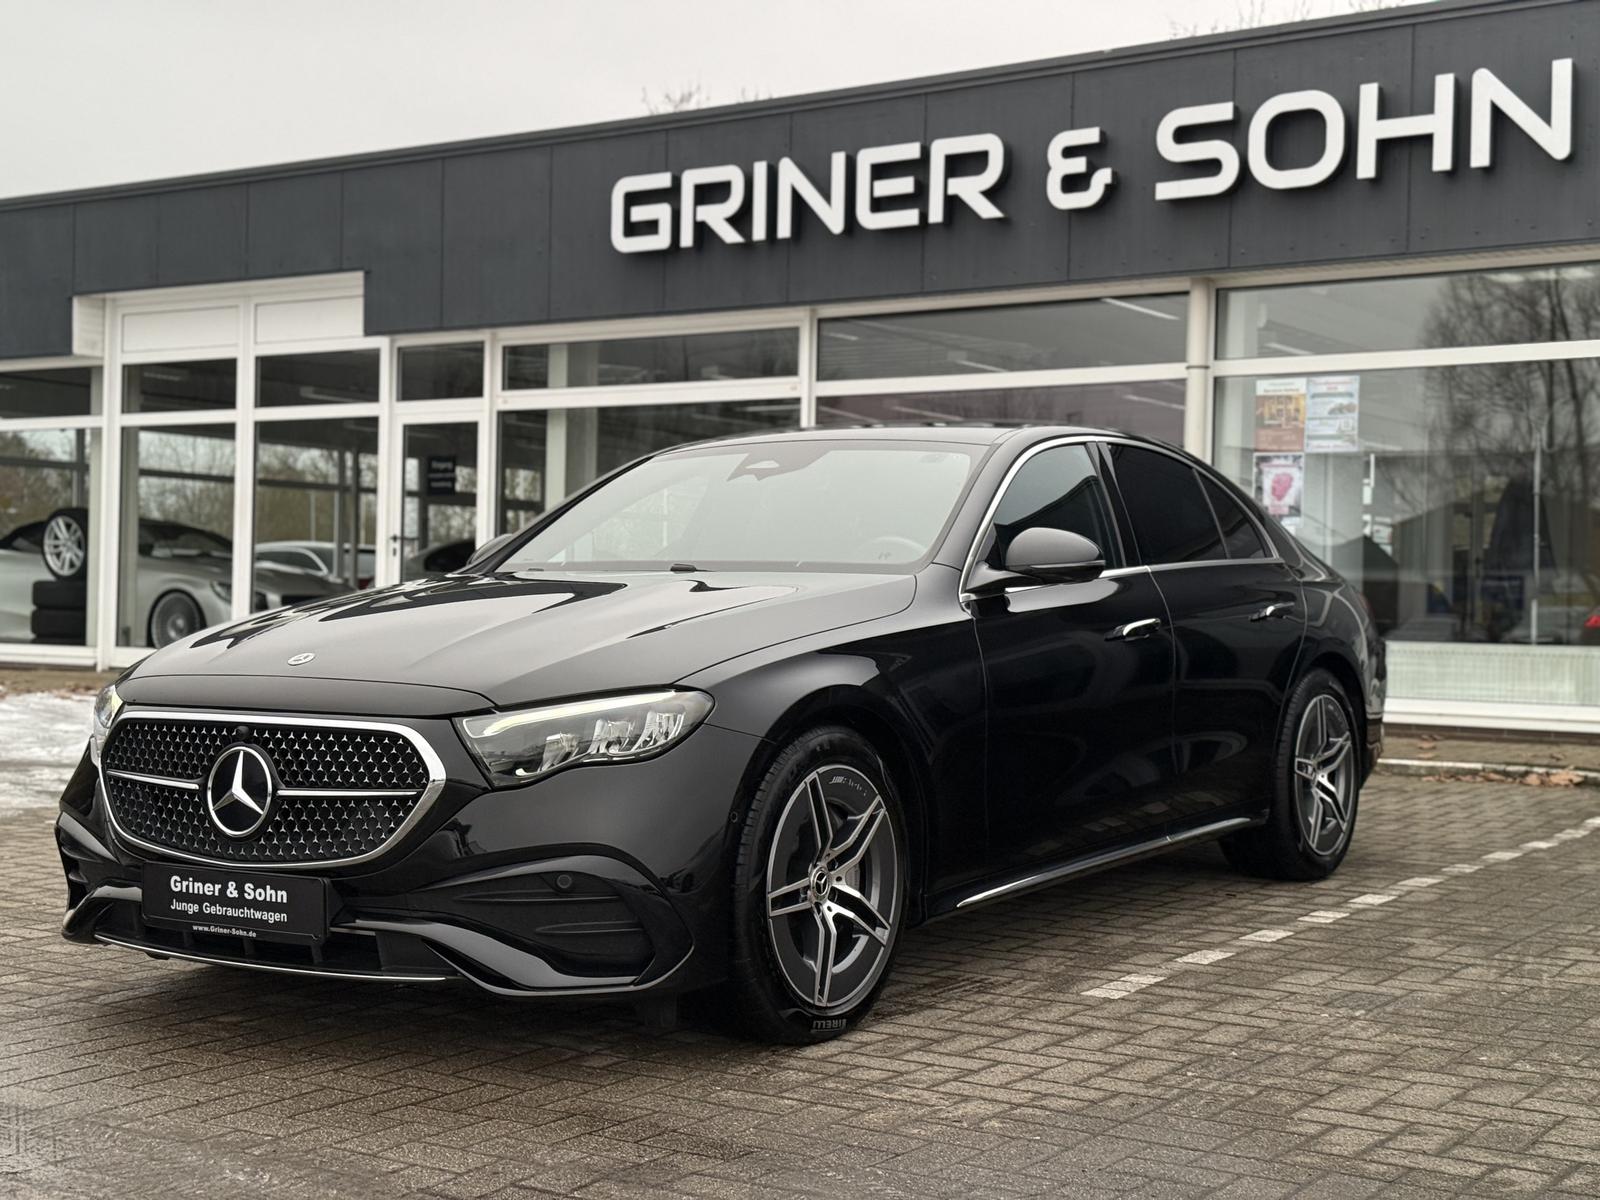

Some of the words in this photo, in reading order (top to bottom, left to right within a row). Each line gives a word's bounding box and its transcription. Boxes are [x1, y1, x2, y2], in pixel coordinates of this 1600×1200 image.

[611, 133, 1004, 253] GRINER
[1046, 126, 1112, 210] &
[1155, 57, 1573, 200] SOHN
[170, 875, 222, 897] Griner
[226, 881, 239, 898] &
[244, 883, 288, 903] Sohn
[170, 899, 199, 914] Junge
[202, 902, 288, 924] Gebrauchtwagen
[192, 925, 257, 938] www.Griner-Sohn.de
